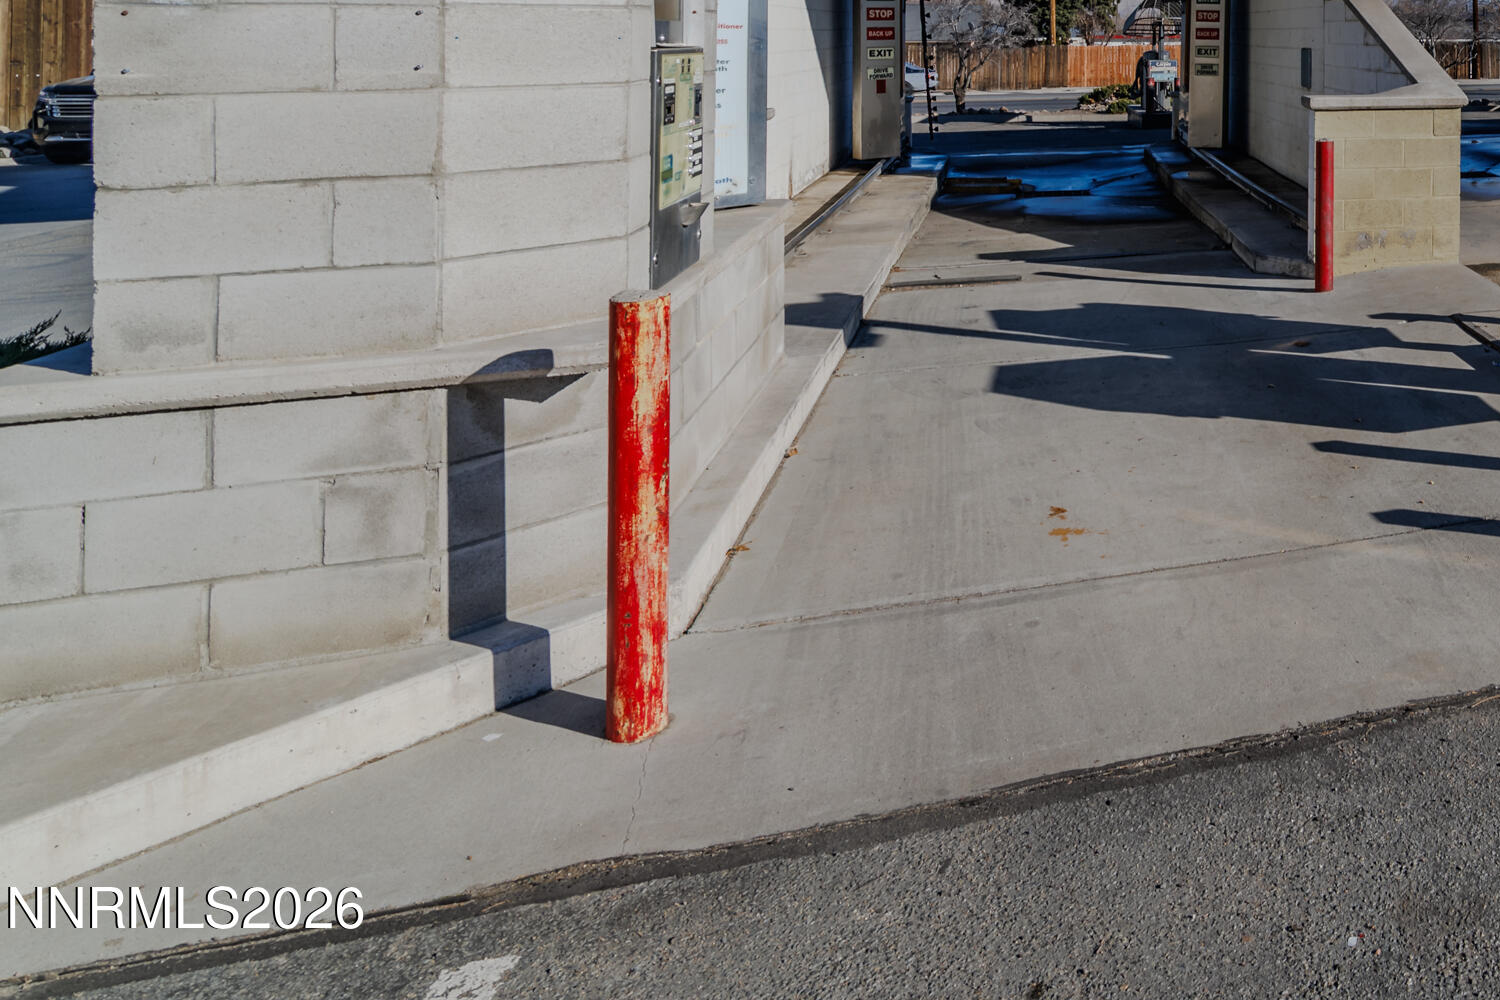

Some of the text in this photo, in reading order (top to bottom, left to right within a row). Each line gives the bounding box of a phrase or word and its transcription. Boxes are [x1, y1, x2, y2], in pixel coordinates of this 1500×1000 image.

[868, 9, 893, 18] STOP
[1197, 12, 1219, 20] STOP
[868, 49, 893, 58] EXIT
[1197, 48, 1218, 56] EXIT
[869, 72, 893, 80] FORWARD
